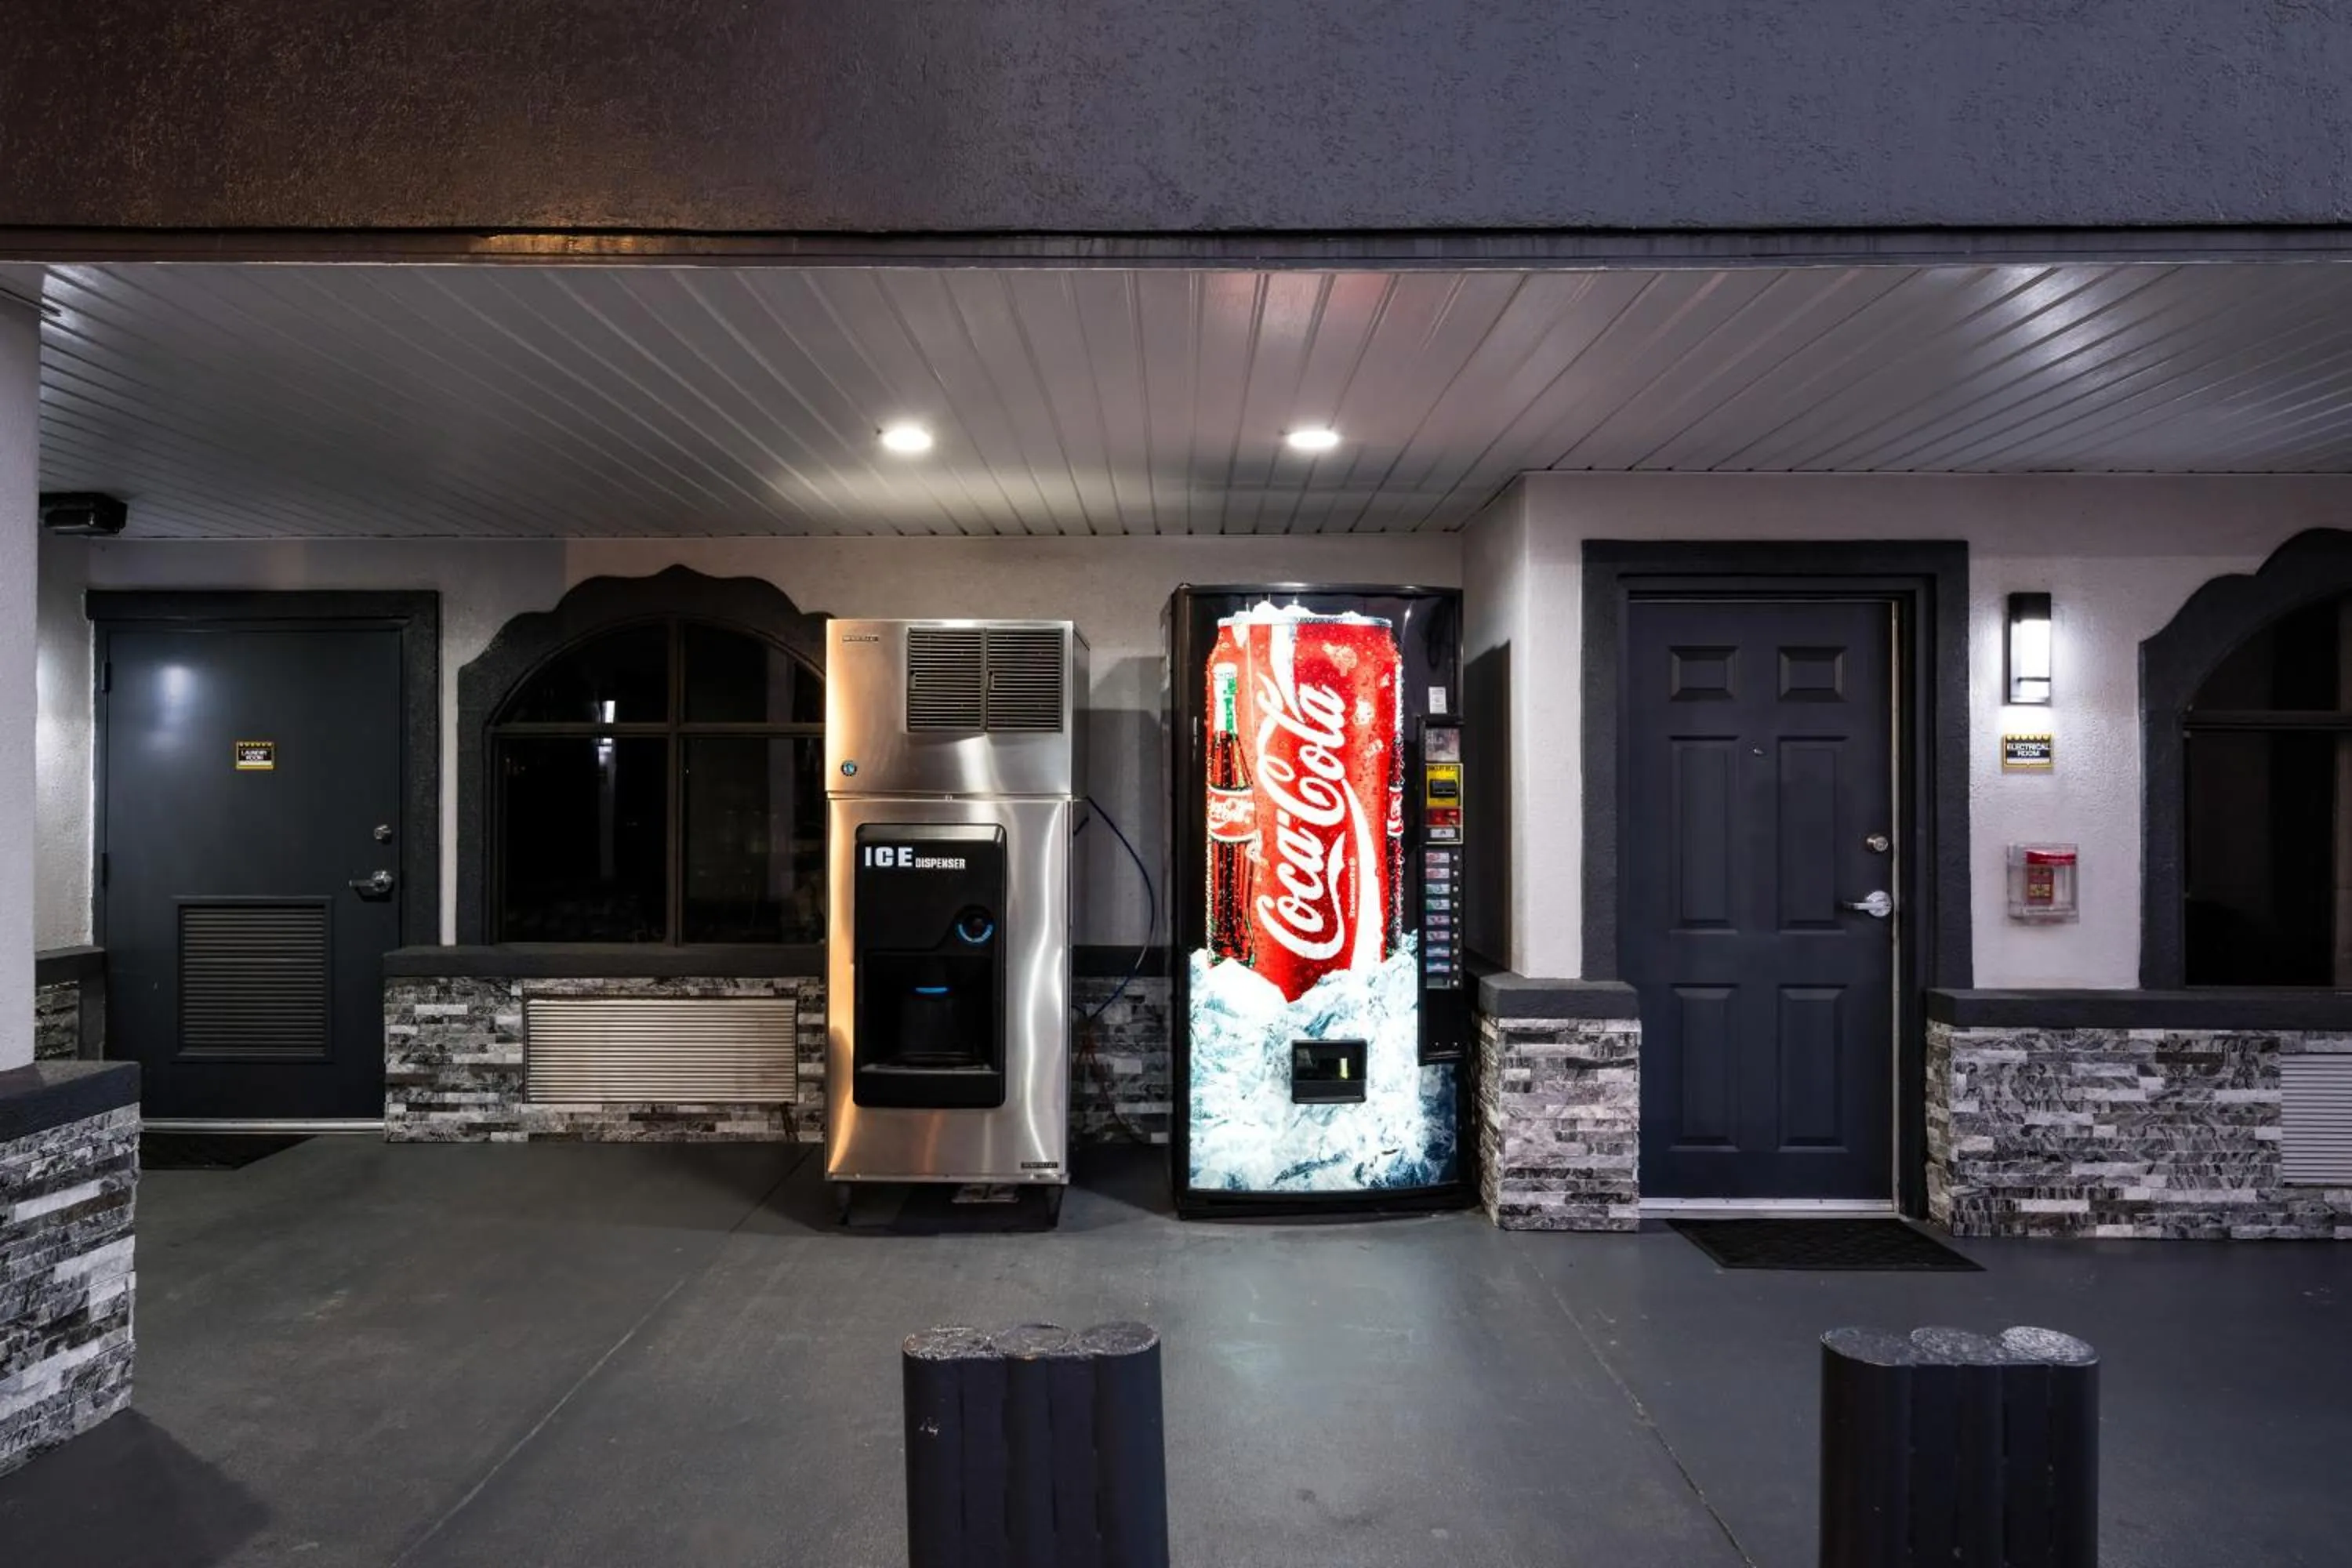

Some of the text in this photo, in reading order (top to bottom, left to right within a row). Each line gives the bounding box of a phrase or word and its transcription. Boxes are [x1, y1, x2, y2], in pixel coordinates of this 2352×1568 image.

[865, 846, 966, 869] ICE DISPENSER
[1256, 673, 1346, 960] Coca-Cola
